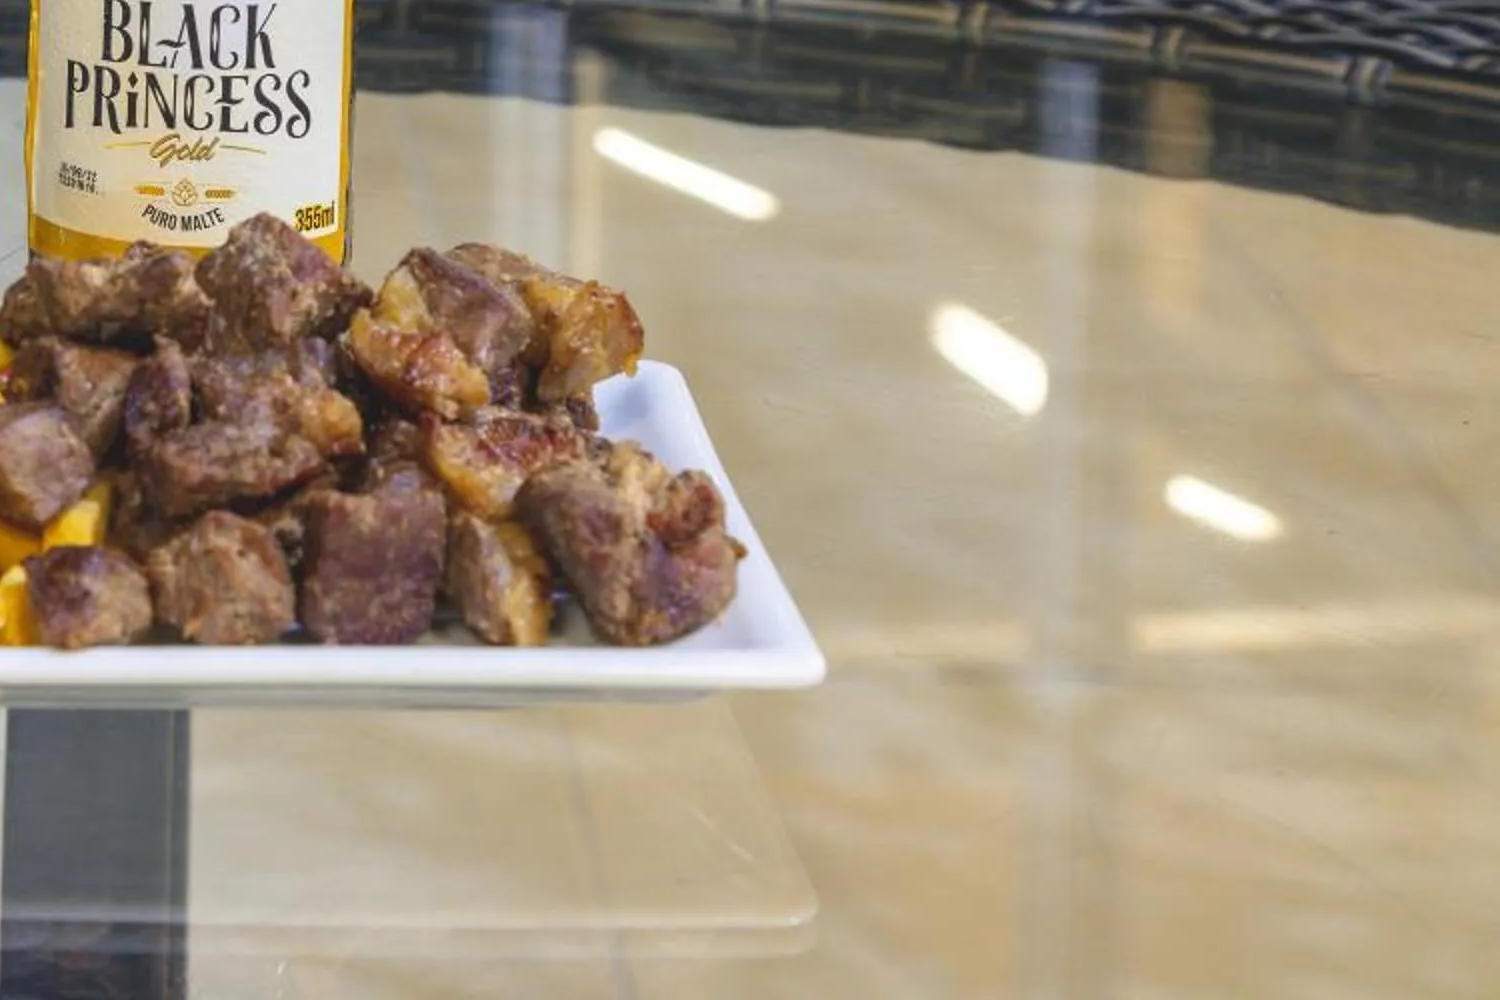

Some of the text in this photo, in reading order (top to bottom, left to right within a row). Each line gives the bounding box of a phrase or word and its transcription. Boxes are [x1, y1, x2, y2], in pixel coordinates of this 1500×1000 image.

[150, 133, 220, 168] Gold
[141, 204, 225, 232] PURO MALTE
[295, 200, 335, 232] 355ml
